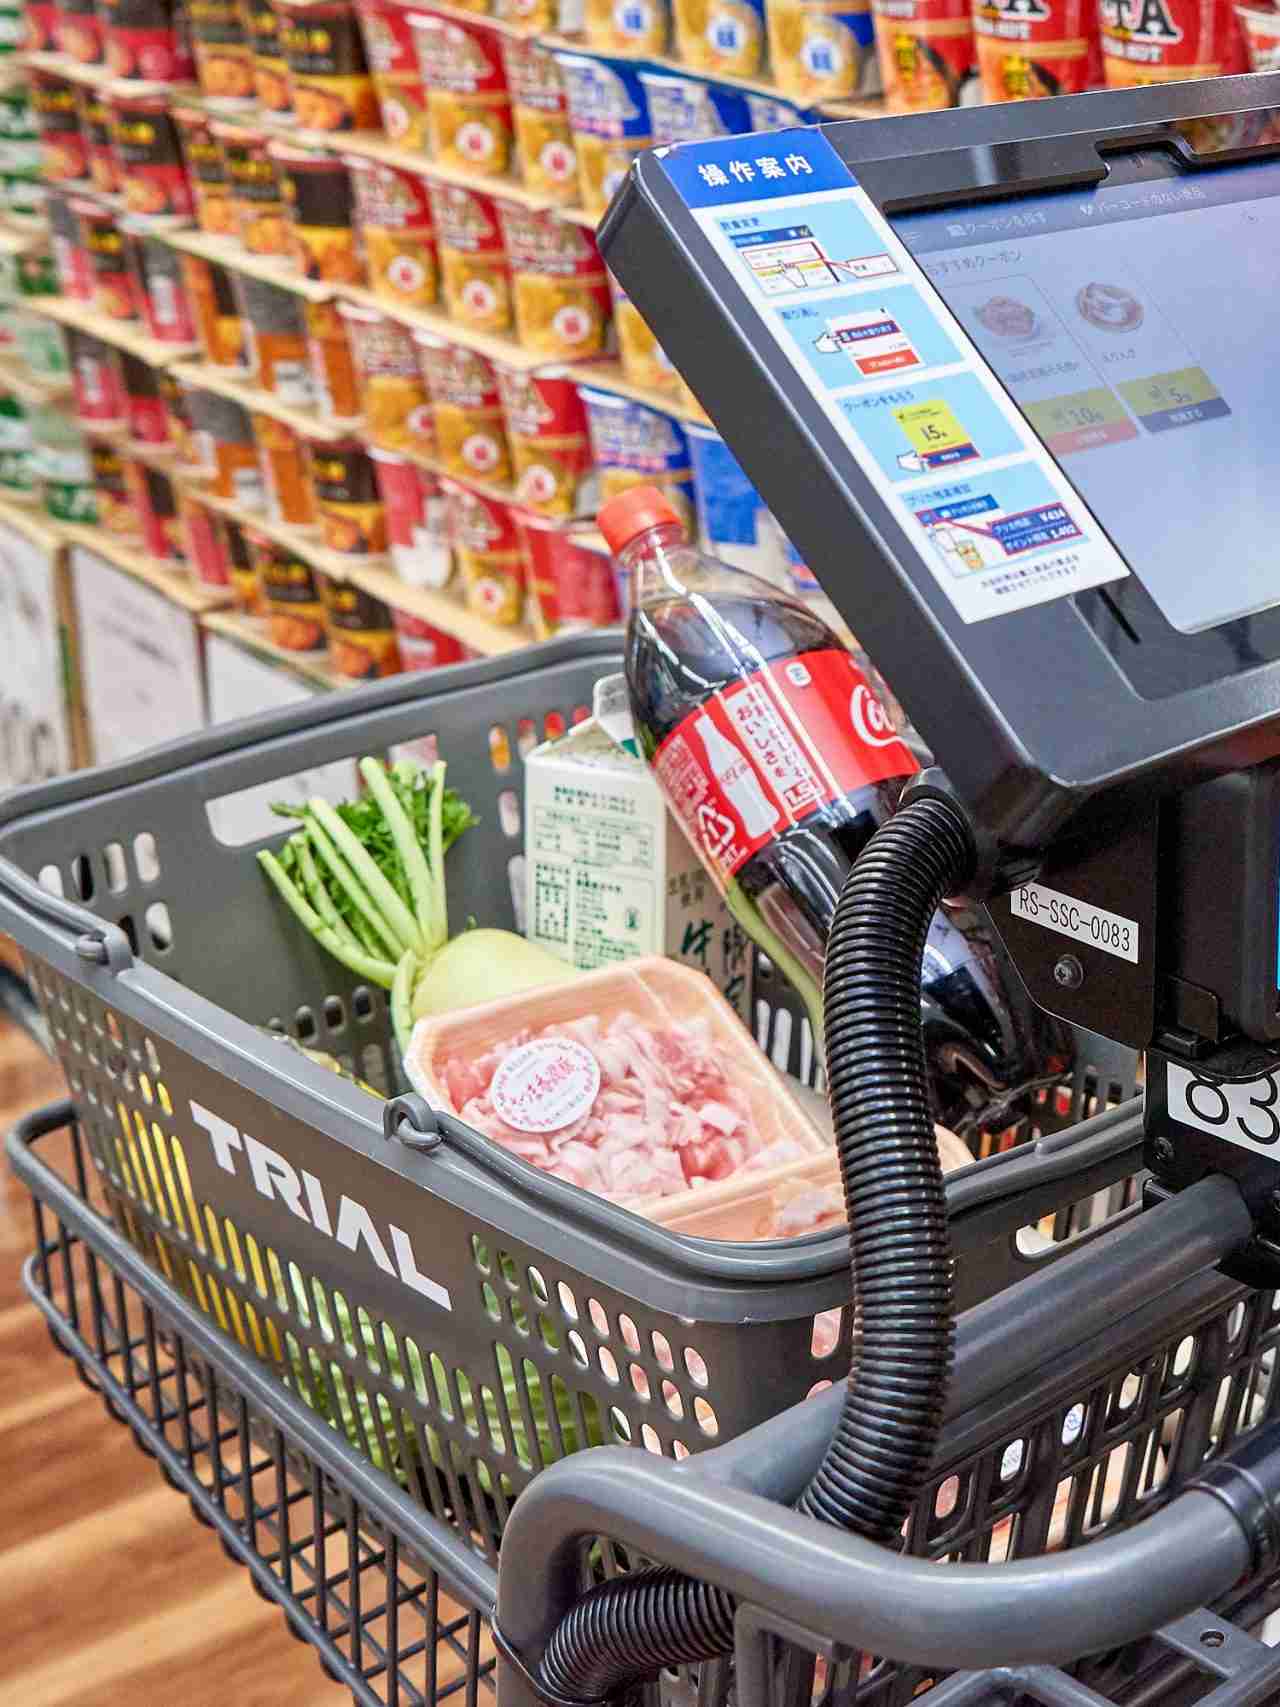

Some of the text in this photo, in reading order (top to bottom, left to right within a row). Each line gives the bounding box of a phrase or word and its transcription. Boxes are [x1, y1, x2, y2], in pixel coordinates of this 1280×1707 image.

[698, 153, 815, 188] 操作案内
[1019, 887, 1131, 952] RS-SSC-0083
[188, 1100, 453, 1312] TRIAL
